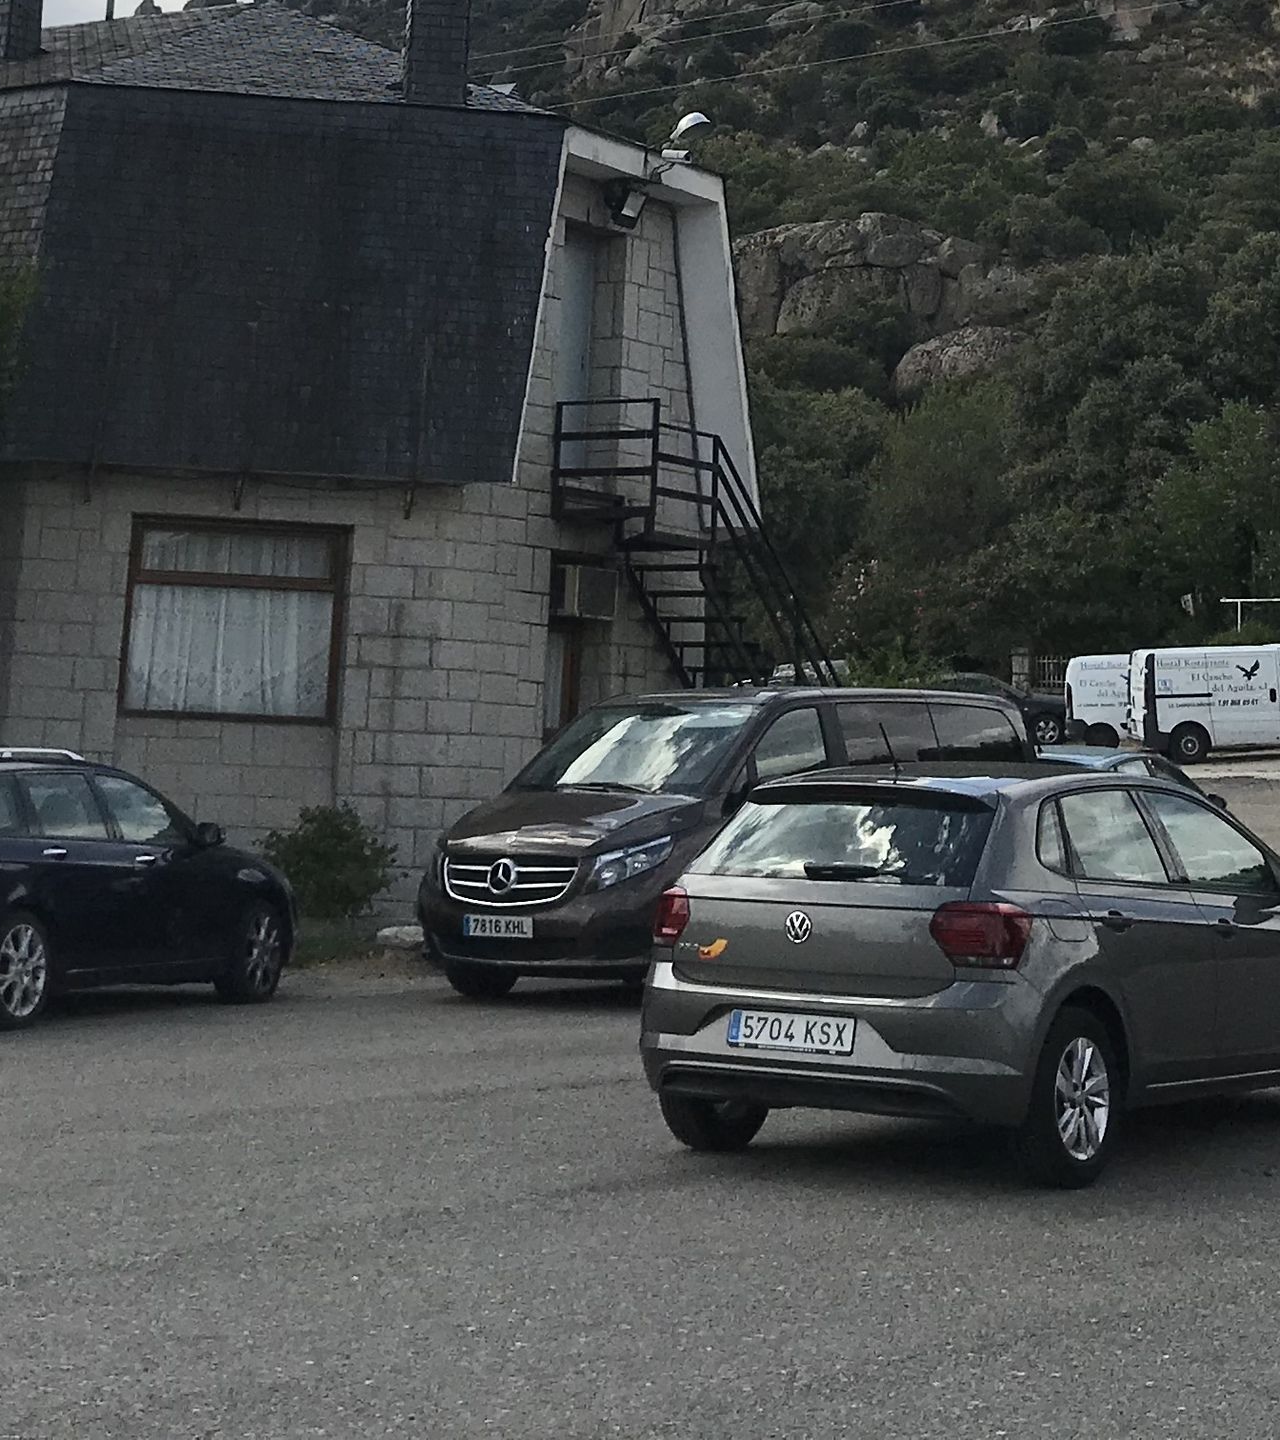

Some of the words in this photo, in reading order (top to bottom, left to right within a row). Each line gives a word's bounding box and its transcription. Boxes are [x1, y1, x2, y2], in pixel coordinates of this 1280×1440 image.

[472, 918, 501, 933] 7816
[504, 920, 528, 935] KHL
[743, 1014, 795, 1042] 5704
[803, 1020, 847, 1048] KSX
